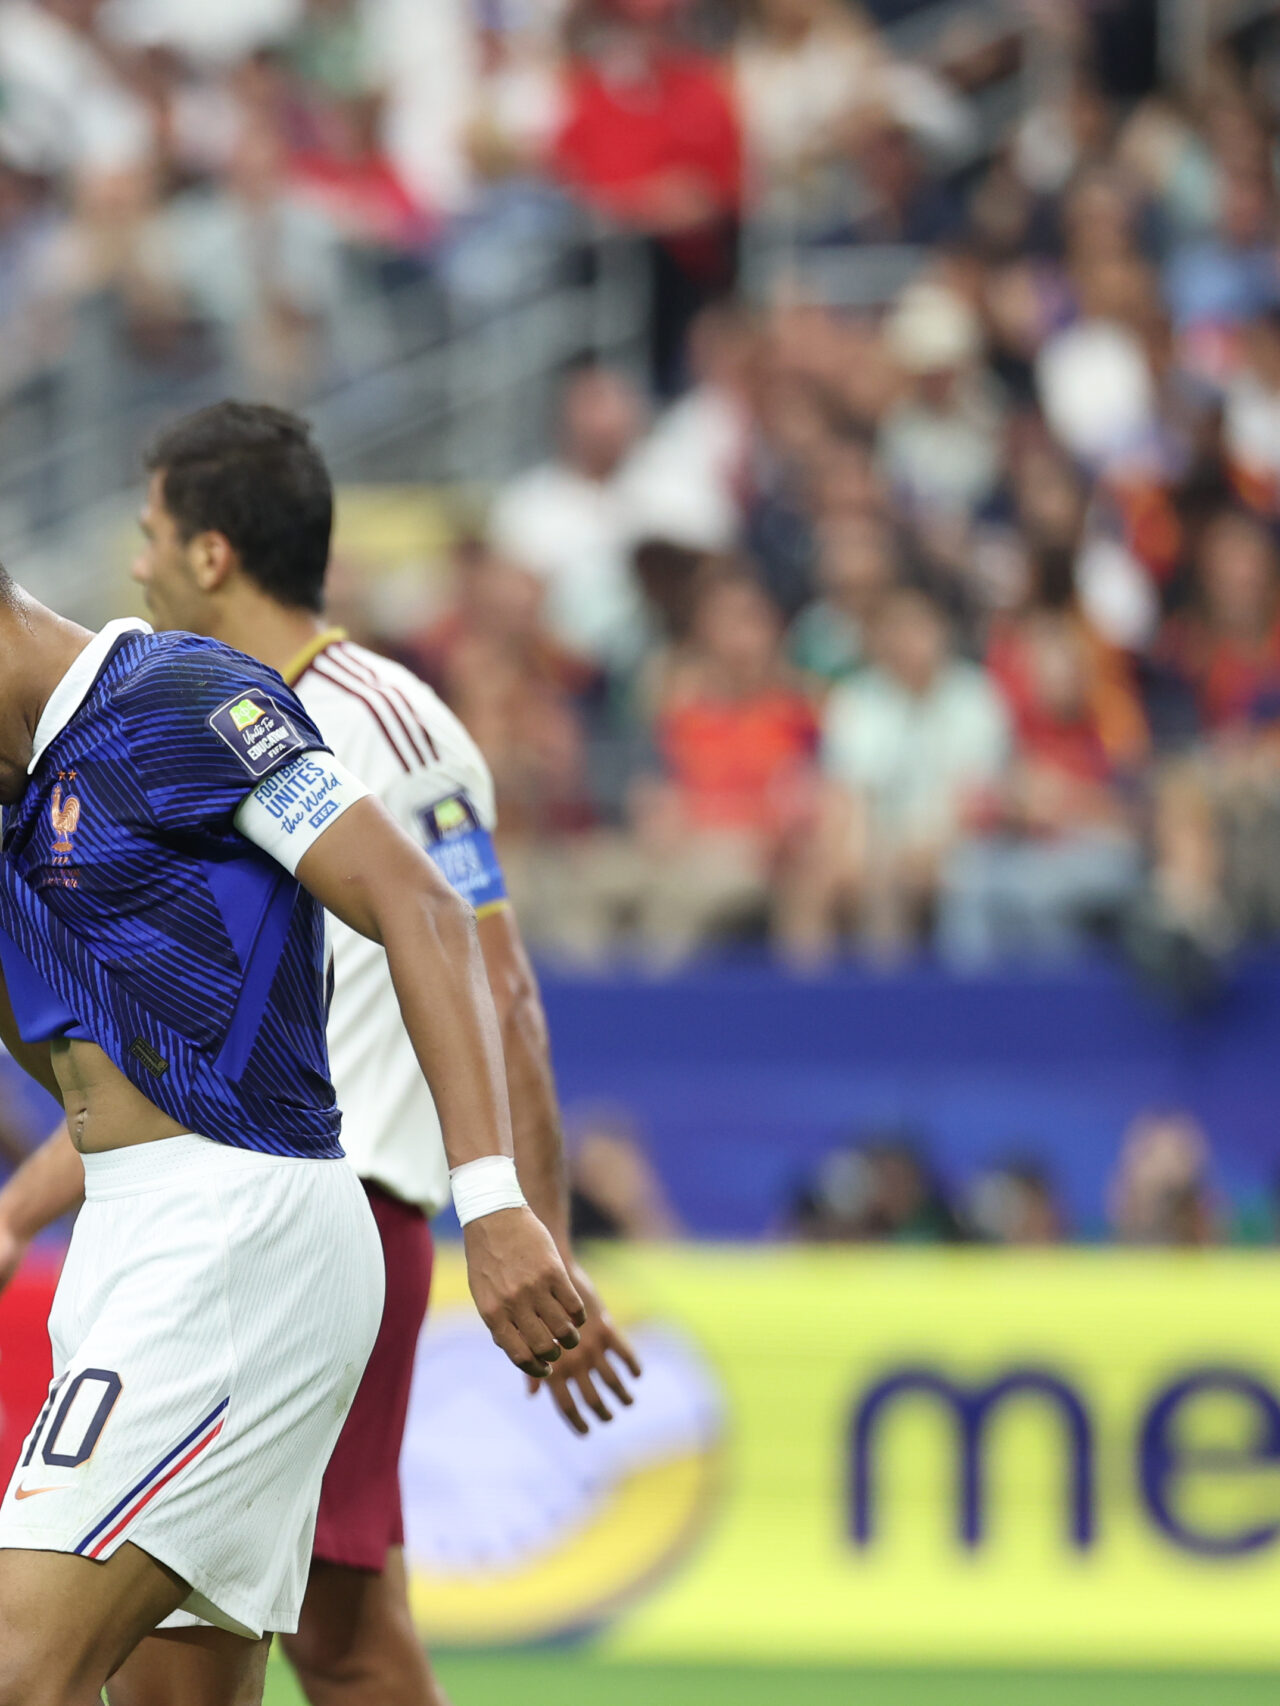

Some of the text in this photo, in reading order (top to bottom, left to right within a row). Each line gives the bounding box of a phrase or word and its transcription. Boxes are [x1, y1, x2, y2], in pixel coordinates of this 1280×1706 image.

[246, 725, 290, 761] EDUCATION
[267, 743, 286, 758] FIFA
[253, 754, 309, 805] FOOTBALL
[265, 762, 324, 818] UNITES
[280, 771, 343, 835] the World
[311, 802, 338, 827] FIFA
[21, 1367, 124, 1469] 10
[844, 1362, 1280, 1562] me
